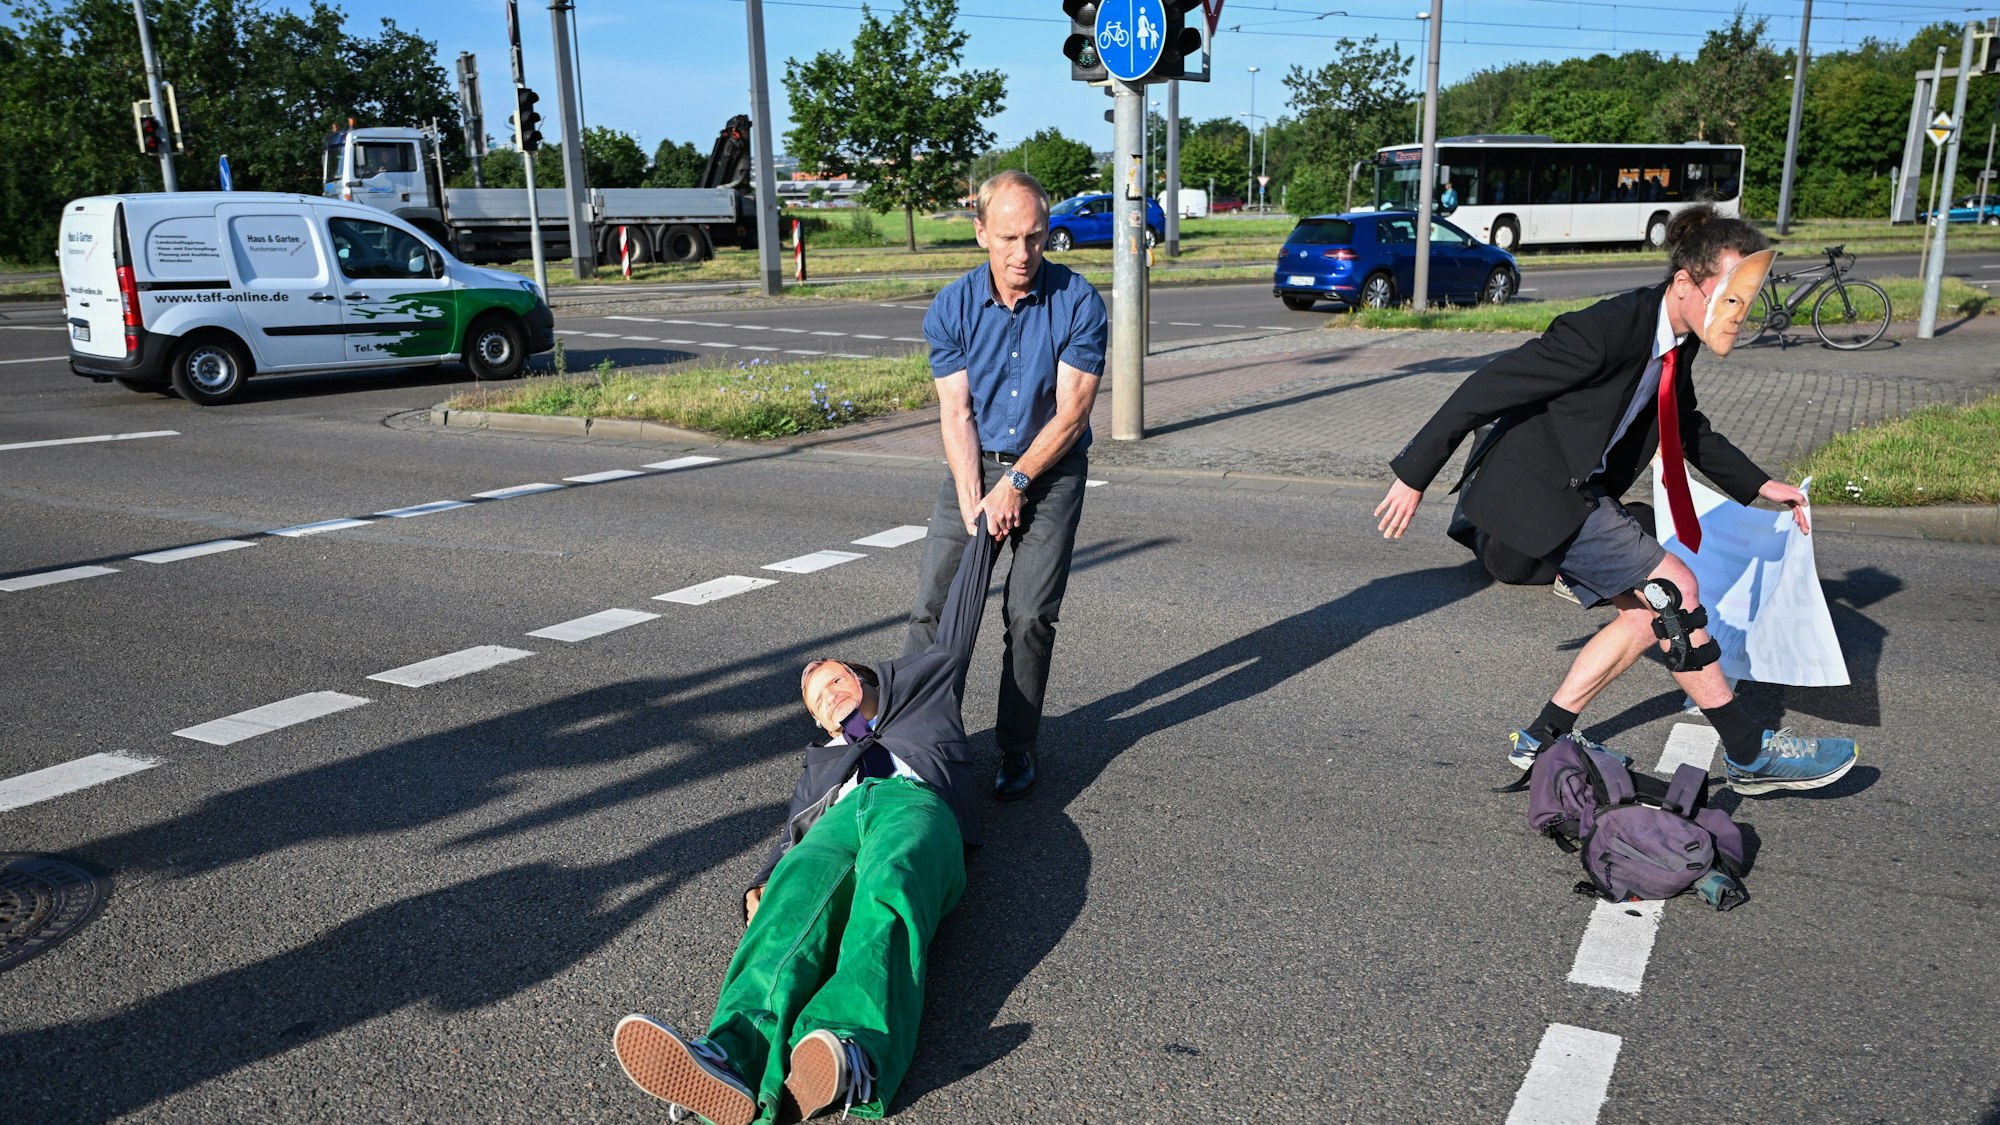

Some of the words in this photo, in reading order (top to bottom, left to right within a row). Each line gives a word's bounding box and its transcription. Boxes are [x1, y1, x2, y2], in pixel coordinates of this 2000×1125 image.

[247, 235, 266, 243] Haus
[267, 235, 273, 243] &
[275, 235, 300, 243] Garten
[154, 292, 290, 303] www.taff-online.de
[354, 344, 372, 352] Tel.
